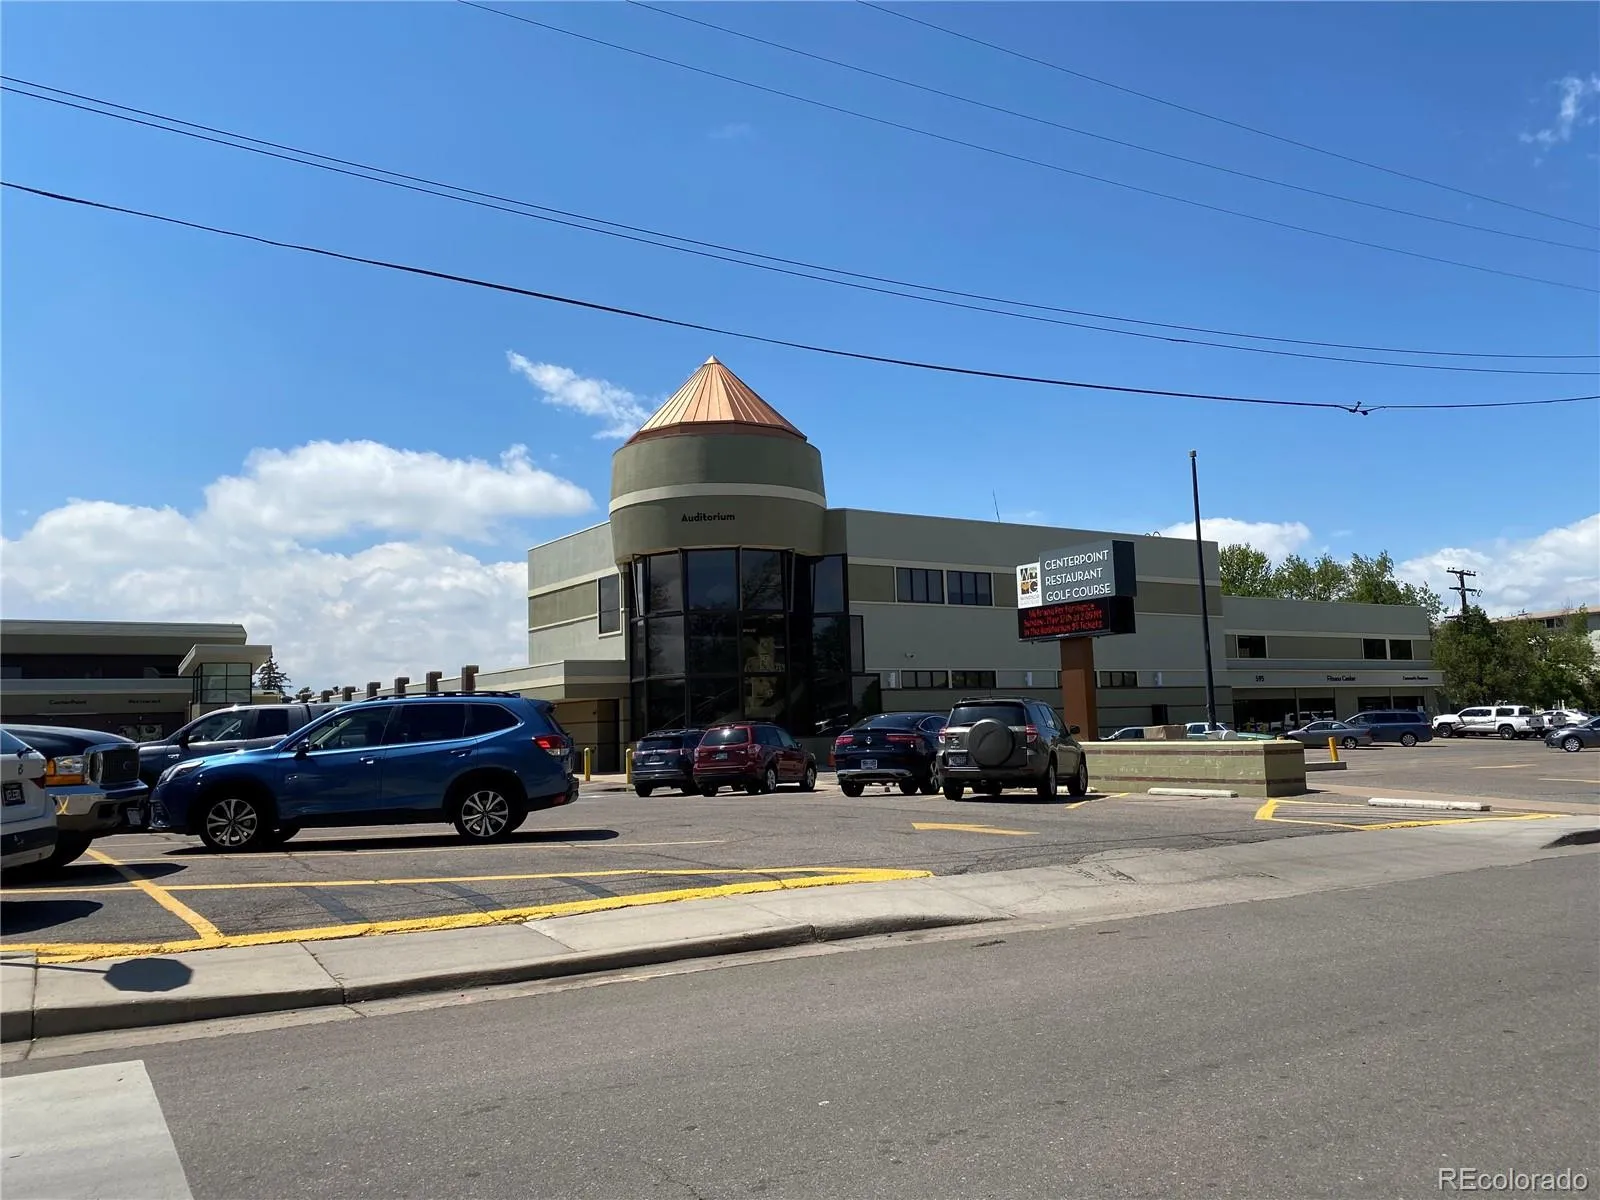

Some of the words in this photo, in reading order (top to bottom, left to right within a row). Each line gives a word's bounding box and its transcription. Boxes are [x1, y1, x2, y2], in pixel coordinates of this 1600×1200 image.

[681, 512, 736, 522] Auditorium
[1044, 550, 1108, 570] CENTERPOINT
[1045, 567, 1103, 586] RESTAURANT
[1046, 588, 1071, 602] GOLF
[1072, 583, 1111, 598] COURSE
